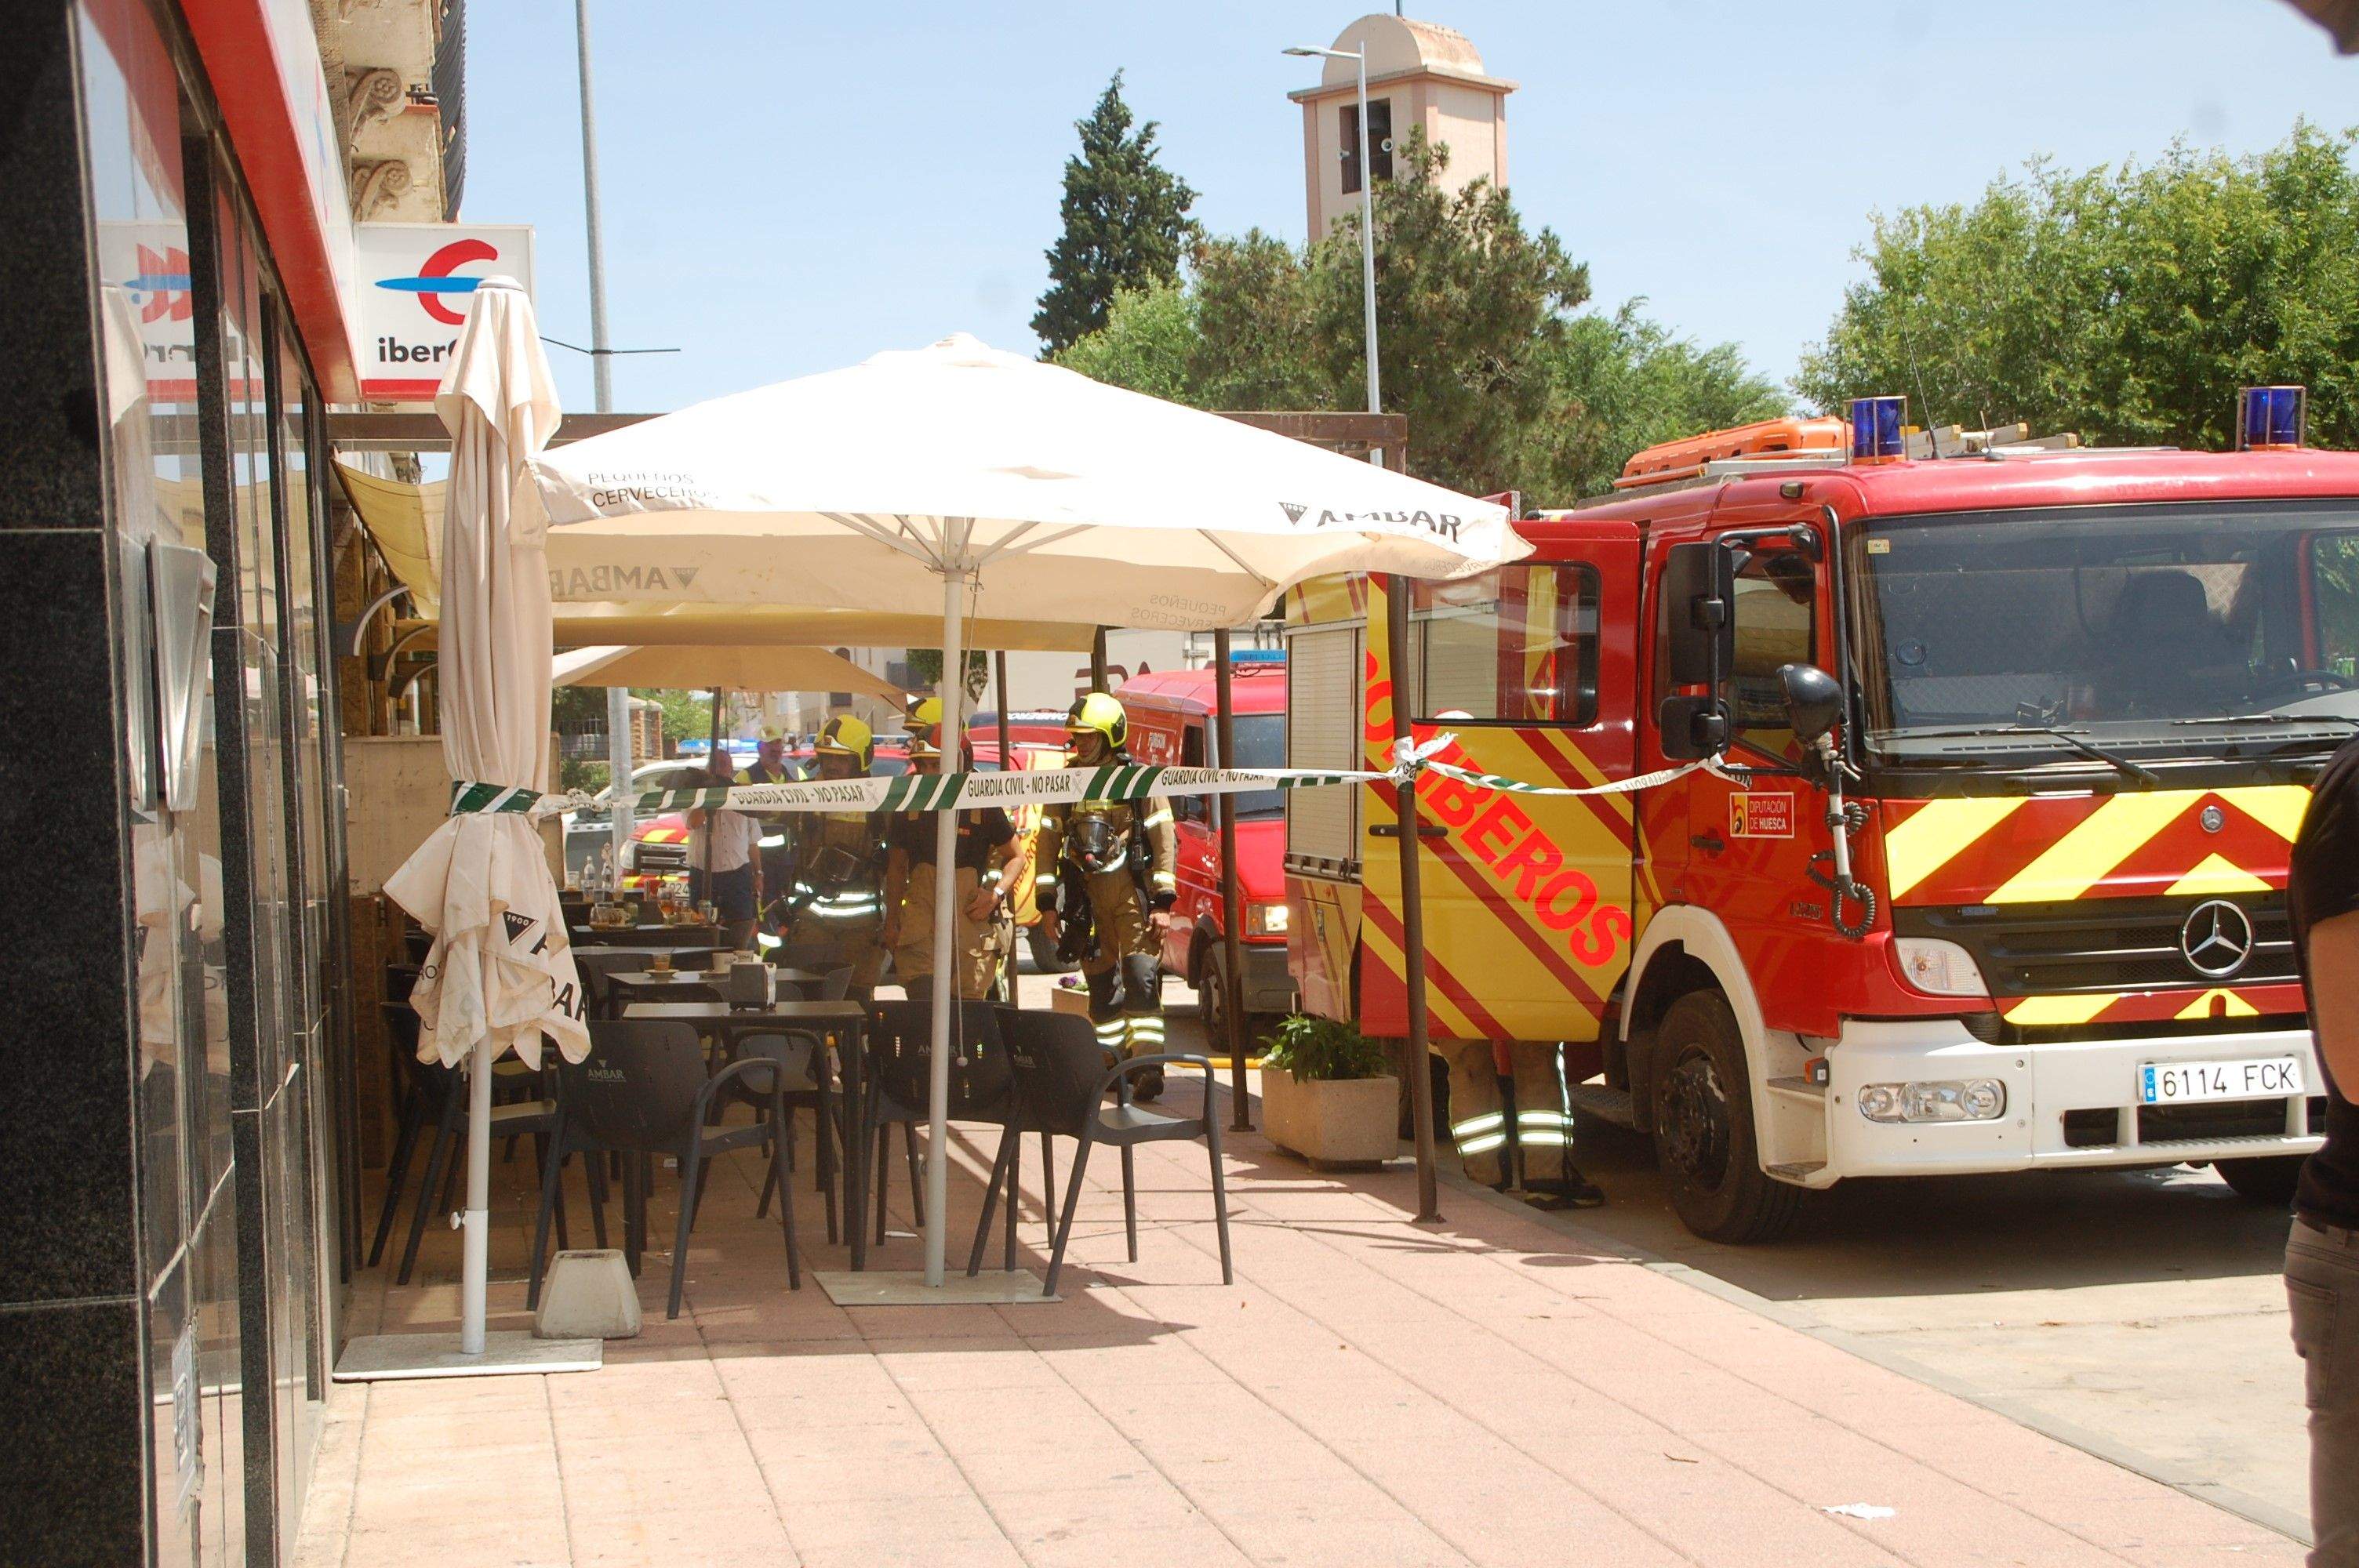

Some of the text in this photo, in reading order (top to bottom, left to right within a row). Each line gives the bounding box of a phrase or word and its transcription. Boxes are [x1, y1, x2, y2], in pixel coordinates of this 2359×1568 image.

[378, 336, 458, 362] iber
[593, 486, 719, 507] CERVECEO
[968, 779, 1003, 798] GUARDIA
[1005, 776, 1025, 795] CIVIL
[1031, 775, 1044, 793] NO
[1045, 774, 1070, 793] PASAR
[1161, 770, 1197, 786] GUARDIA
[1198, 769, 1219, 783] CIVIL
[1226, 771, 1238, 782] NO
[733, 790, 783, 805] GUARDIA
[783, 789, 810, 804] CIVIL
[813, 787, 834, 804] NO
[833, 785, 866, 803] PASAR
[1365, 648, 1632, 970] OMBEROS
[1749, 798, 1787, 813] DIPUTACIÓN
[1750, 817, 1787, 830] DE HUESCA
[506, 913, 529, 927] 1900
[588, 1069, 625, 1080] AMBAR
[2163, 1062, 2295, 1096] 6114 FCK
